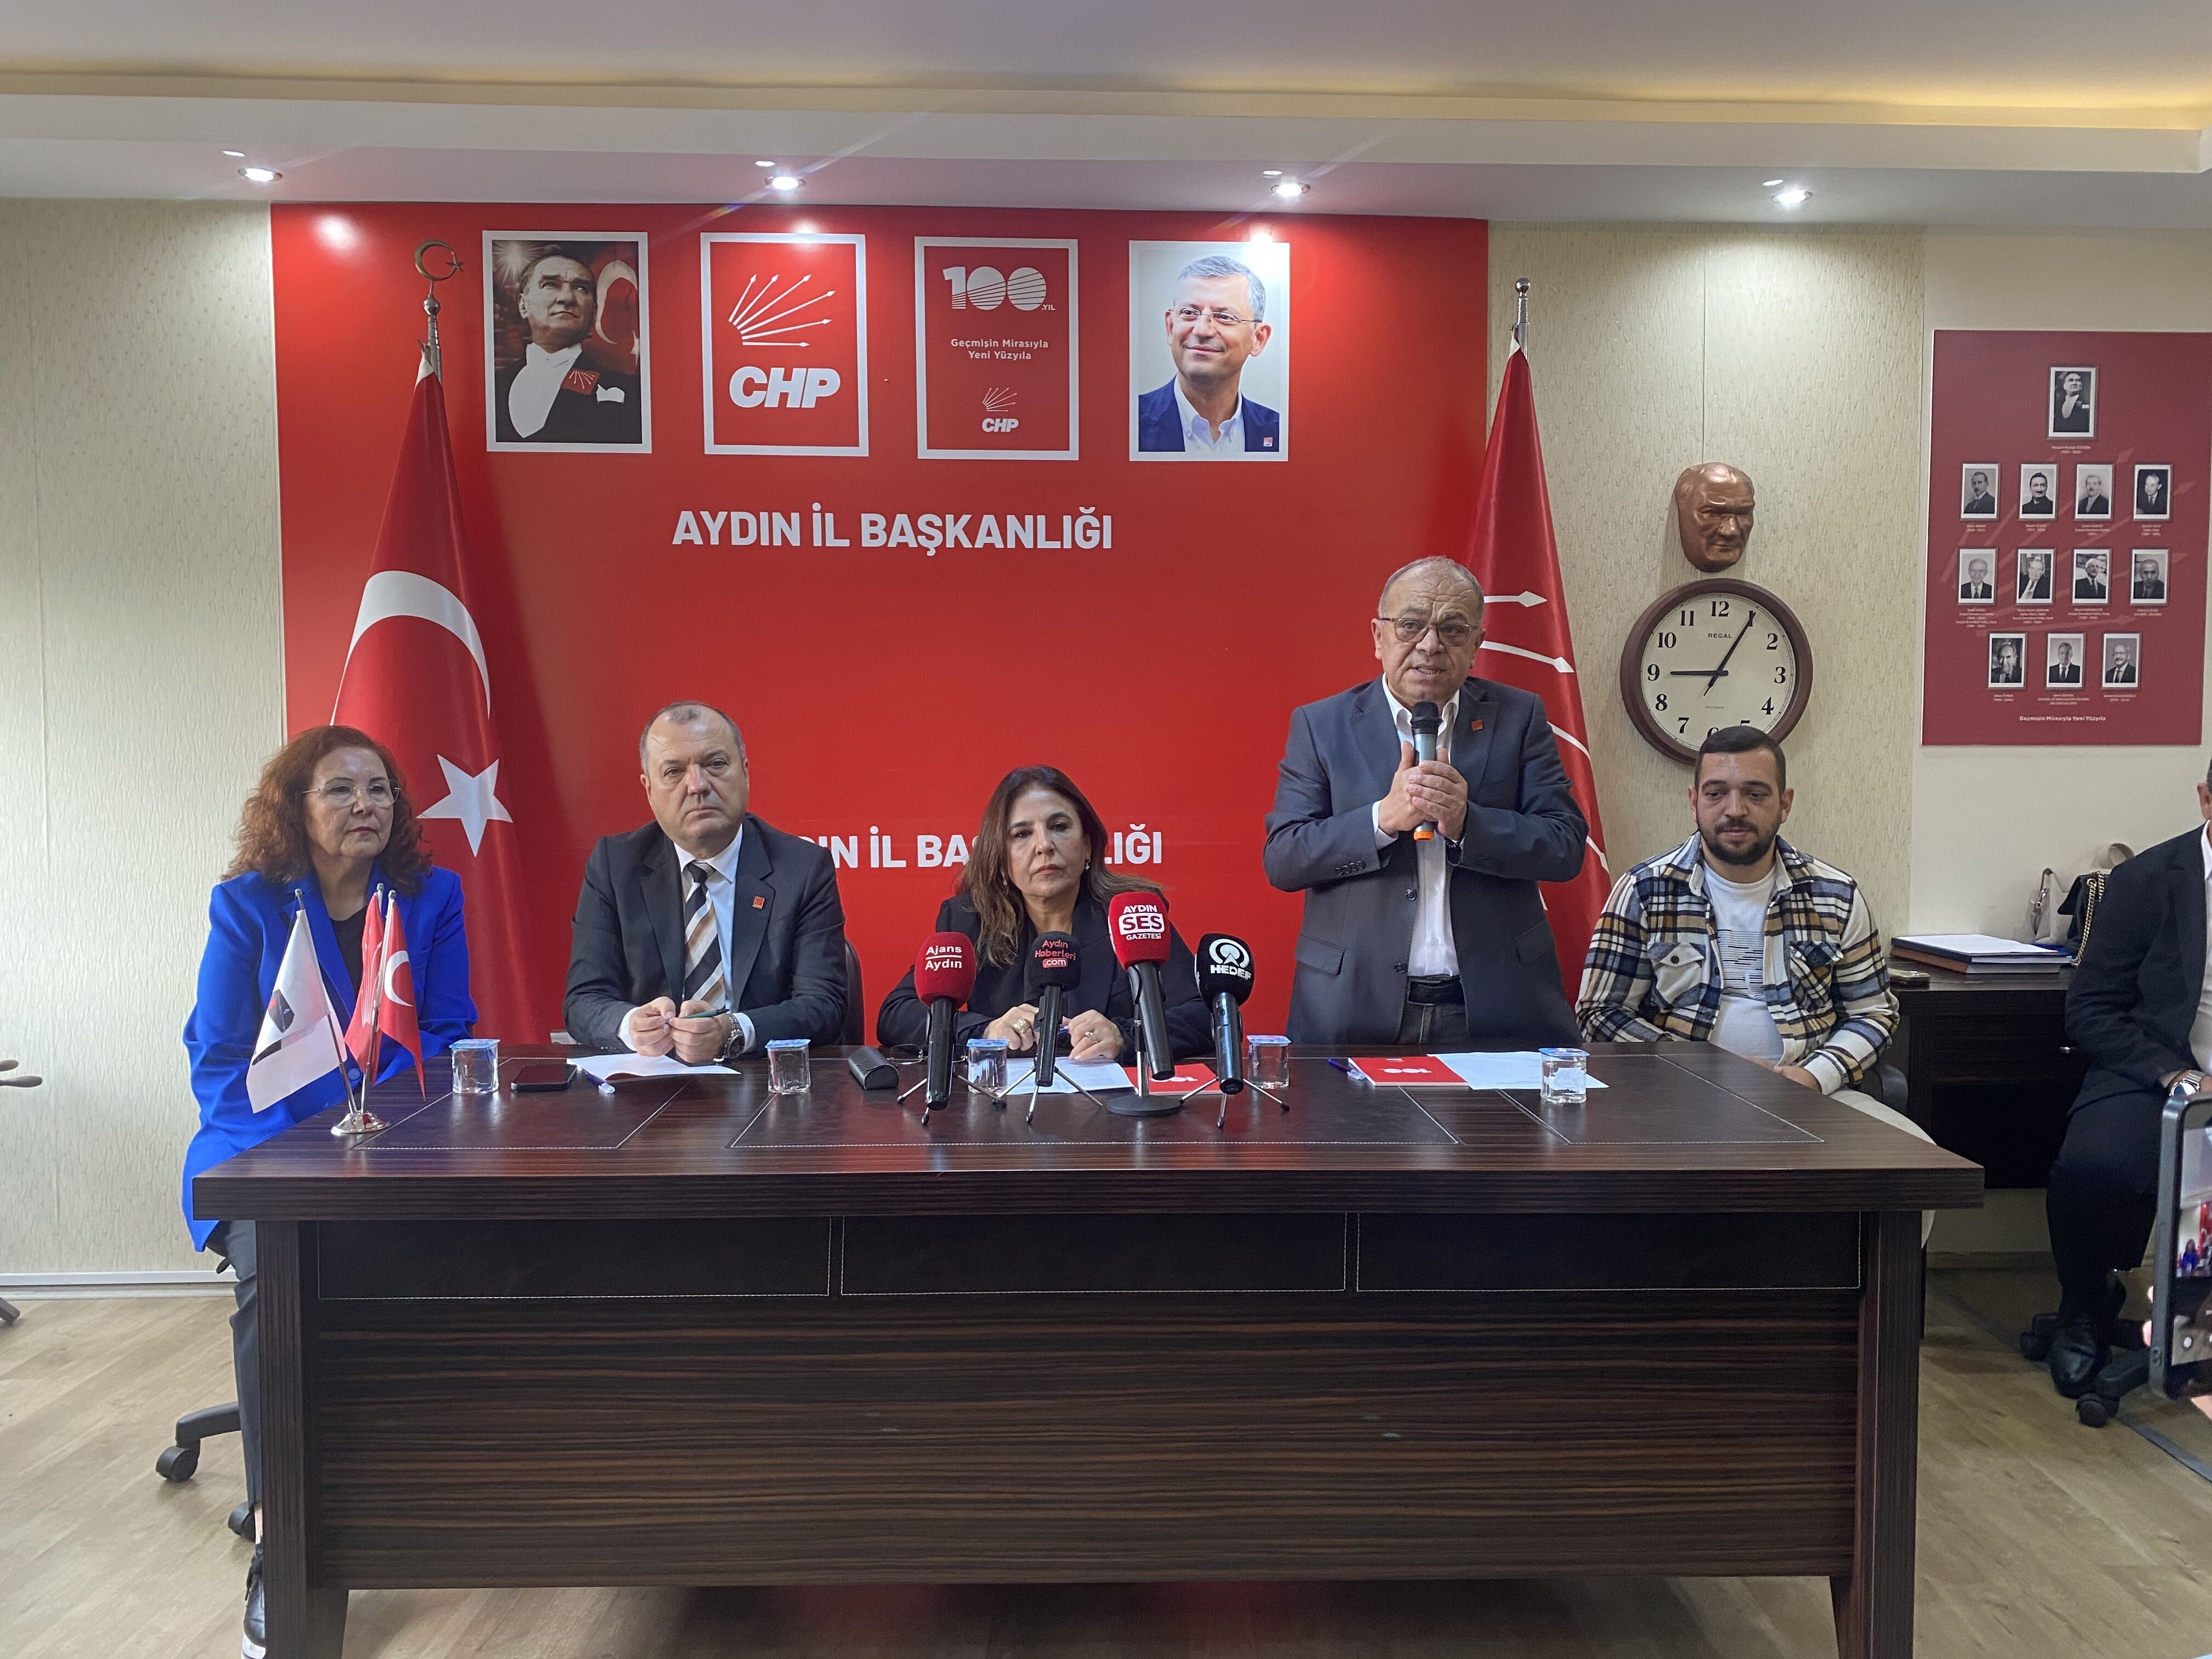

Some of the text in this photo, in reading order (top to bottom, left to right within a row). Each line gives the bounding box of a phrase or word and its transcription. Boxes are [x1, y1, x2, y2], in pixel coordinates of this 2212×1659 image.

[943, 266, 1047, 311] 100
[951, 339, 1048, 349] Geçmişin Mirasıyla
[968, 351, 1031, 360] Yeni Yüzyıla
[729, 366, 840, 408] CHP
[982, 418, 1019, 432] CHP
[672, 502, 1112, 556] AYDIN İL BAŞKANLIĞI
[1711, 601, 1730, 617] 12
[1680, 610, 1695, 627] 11
[1657, 632, 1677, 648] 10
[1767, 633, 1779, 650] 2
[1647, 664, 1660, 681] 9
[1774, 667, 1786, 684] 3
[1655, 693, 1668, 711] 8
[1761, 697, 1774, 715] 4
[1678, 717, 1690, 733] 7
[870, 825, 906, 868] İL
[1123, 905, 1158, 914] AYDIN
[1122, 915, 1163, 931] SES
[926, 945, 963, 956] Ajans
[1042, 939, 1069, 949] Aydın
[1035, 950, 1076, 961] Haberleri
[925, 960, 963, 972] Aydın
[1210, 964, 1251, 980] HEDEF
